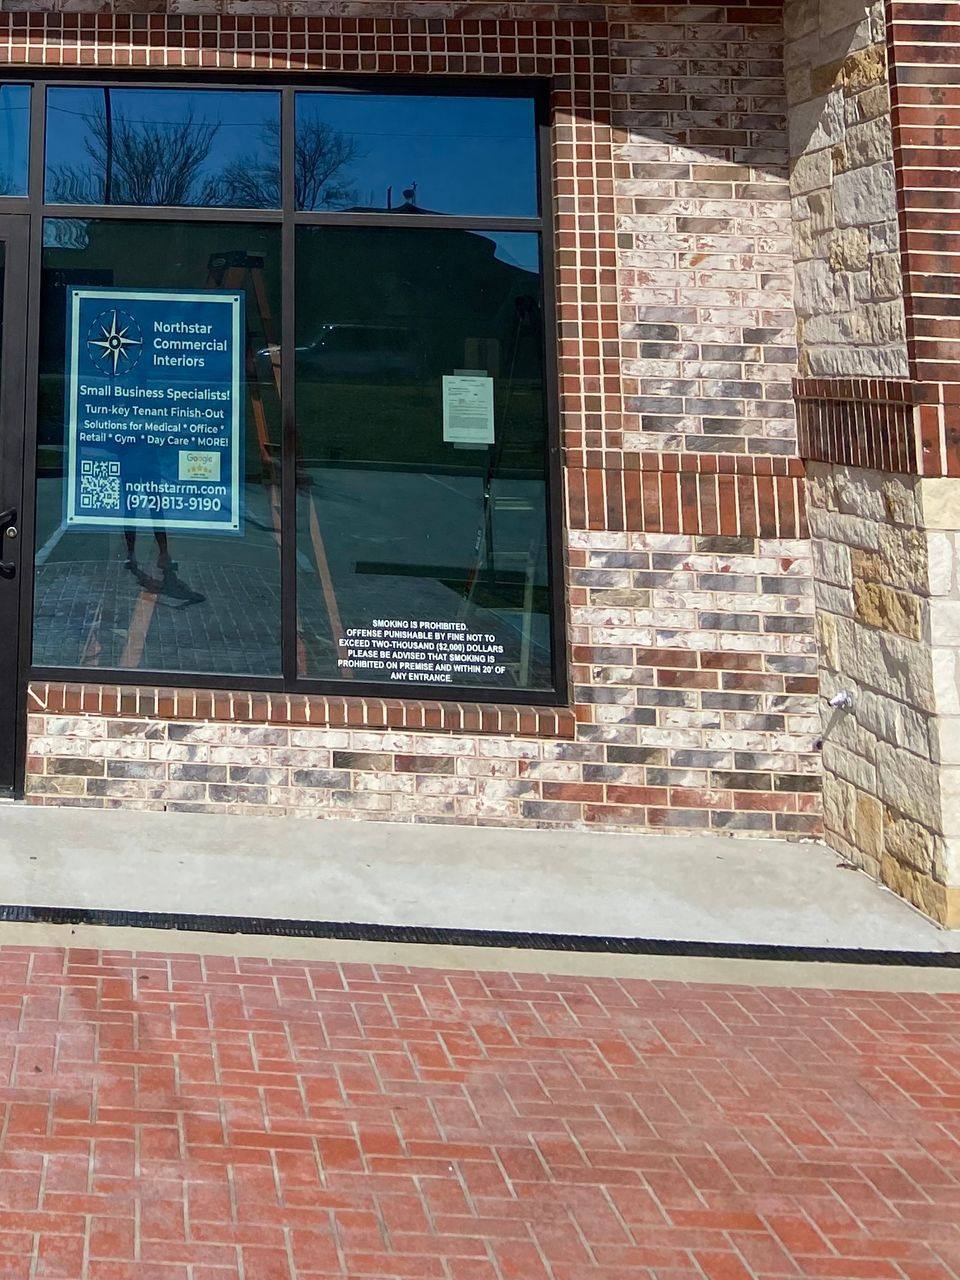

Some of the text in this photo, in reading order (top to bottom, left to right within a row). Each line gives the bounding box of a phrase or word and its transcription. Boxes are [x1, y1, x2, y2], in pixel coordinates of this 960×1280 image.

[153, 321, 213, 335] Northstar
[153, 338, 227, 351] Commercial
[153, 354, 205, 367] Interiors
[79, 385, 230, 401] Small Business Specialists!
[85, 404, 225, 418] Turn-key Tenant Finish-Out
[83, 420, 218, 433] Solutions for Medical Office
[79, 432, 229, 447] Retail Gym Day Care MORE!
[187, 453, 213, 464] Google
[125, 481, 227, 496] northstarrm.com
[126, 495, 221, 512] (972)813-9190
[372, 619, 468, 631] SMOKING IS PROHIBITED.
[346, 629, 495, 643] OFFENSE PUNISHABLE BY FINE NOT TO
[339, 639, 503, 653] EXCEED TWO-THOUSAND ($2,000) DOLLARS
[348, 649, 379, 658] PLEASE
[392, 651, 426, 660] ADVISED
[427, 653, 447, 661] THAT
[449, 654, 486, 662] SMOKING
[487, 655, 495, 663] IS
[337, 659, 384, 669] PROHIBITED
[385, 661, 397, 669] ON
[399, 662, 434, 671] PREMISE
[435, 663, 452, 672] AND
[453, 664, 481, 673] WITHIN
[495, 666, 506, 674] OF
[390, 672, 453, 683] ANY ENTRANCE.
